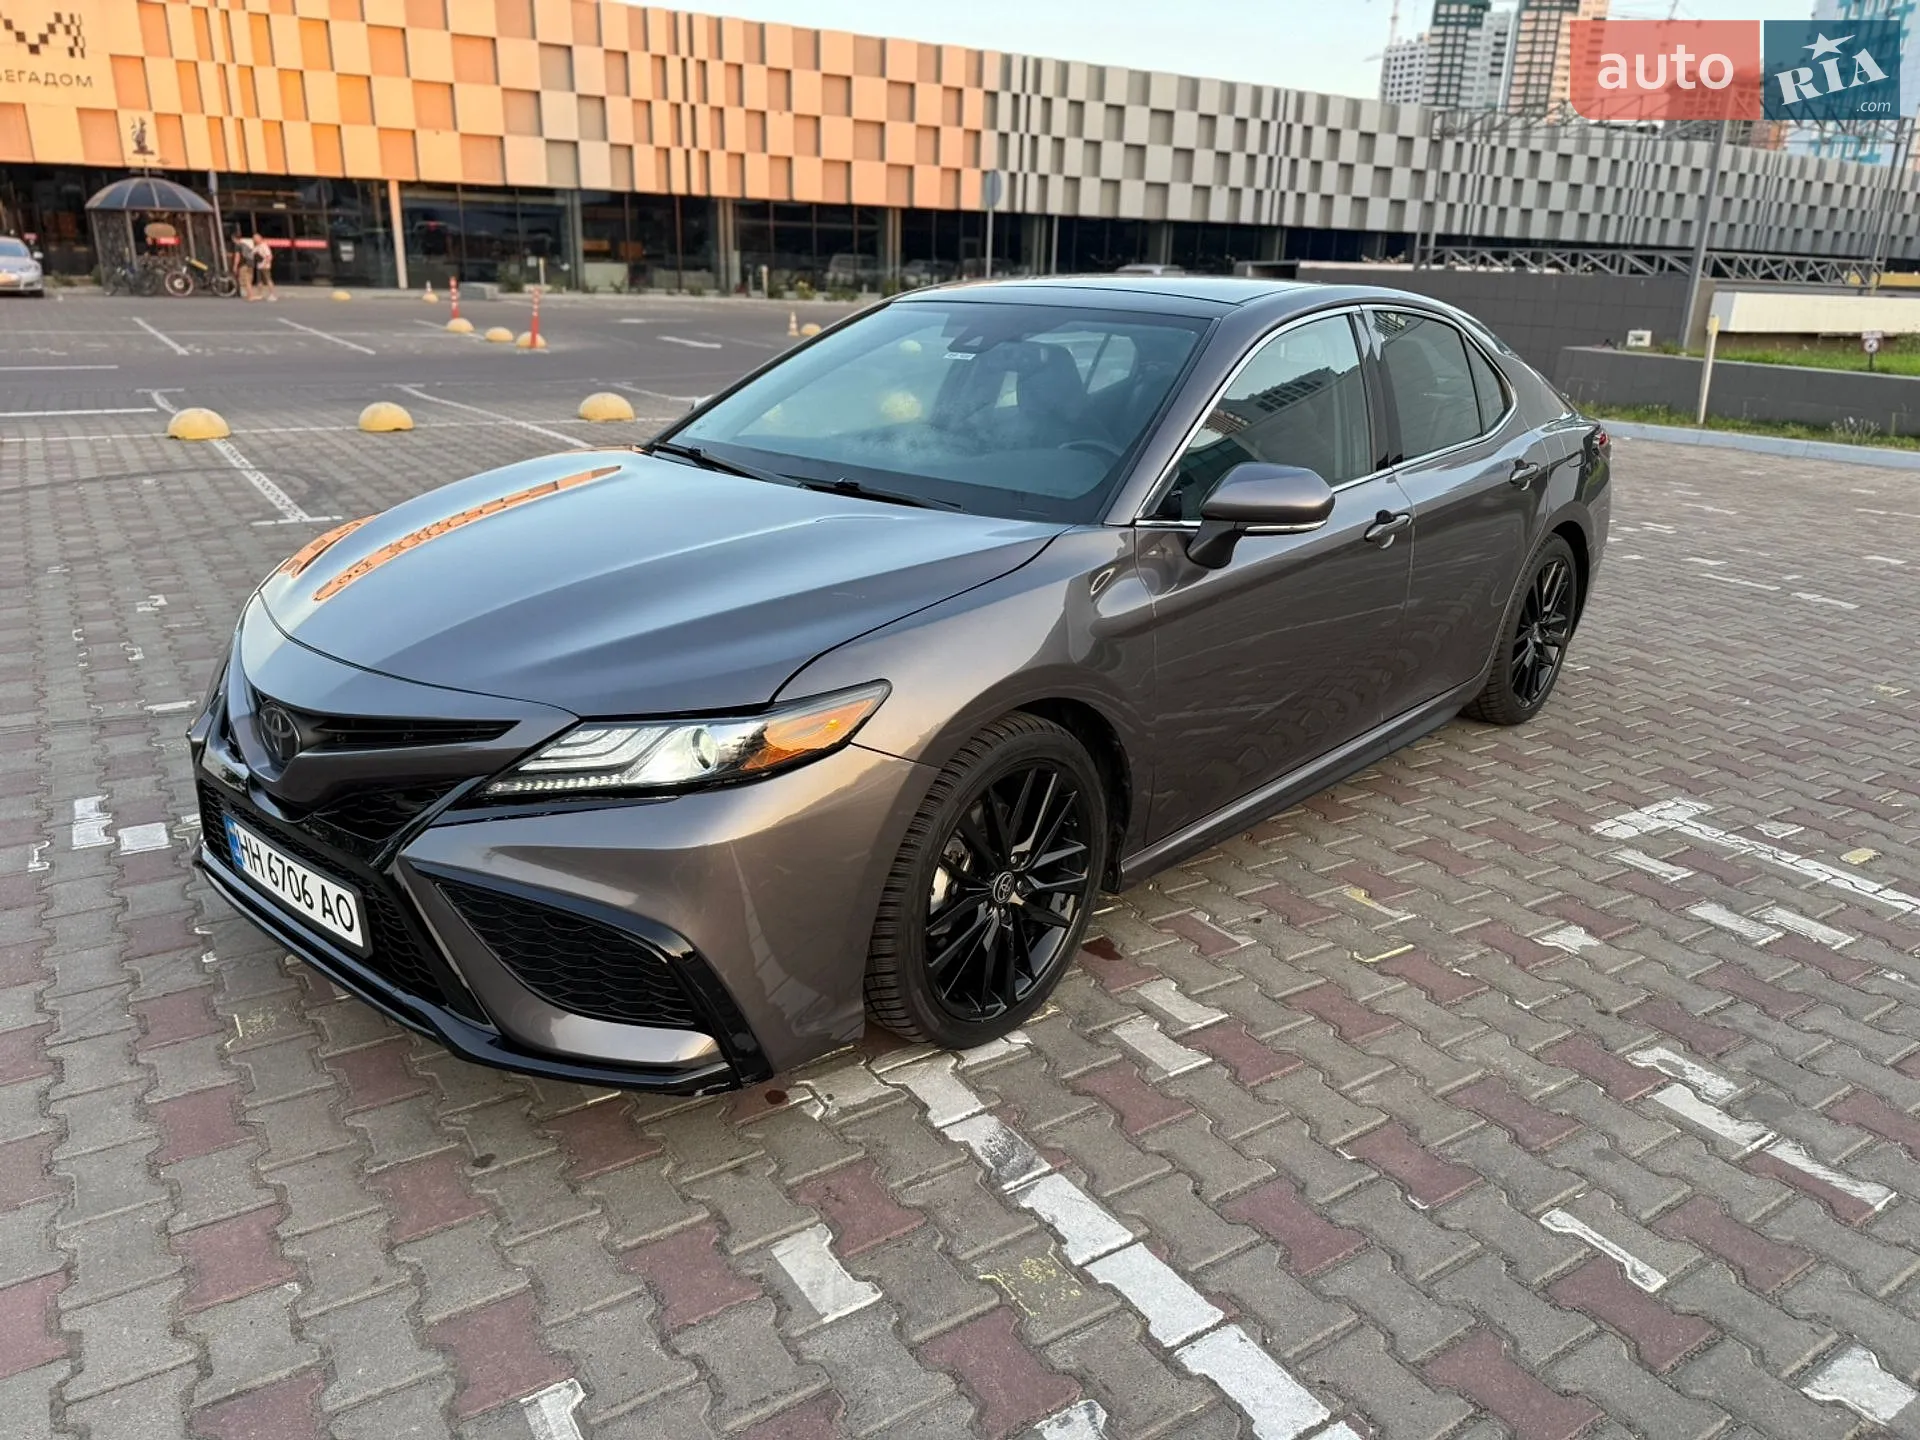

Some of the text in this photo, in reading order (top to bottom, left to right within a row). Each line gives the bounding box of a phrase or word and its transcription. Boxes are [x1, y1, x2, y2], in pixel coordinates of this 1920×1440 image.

[0, 69, 93, 88] ЕГАДОМ
[236, 829, 355, 932] HH 6706 AO
